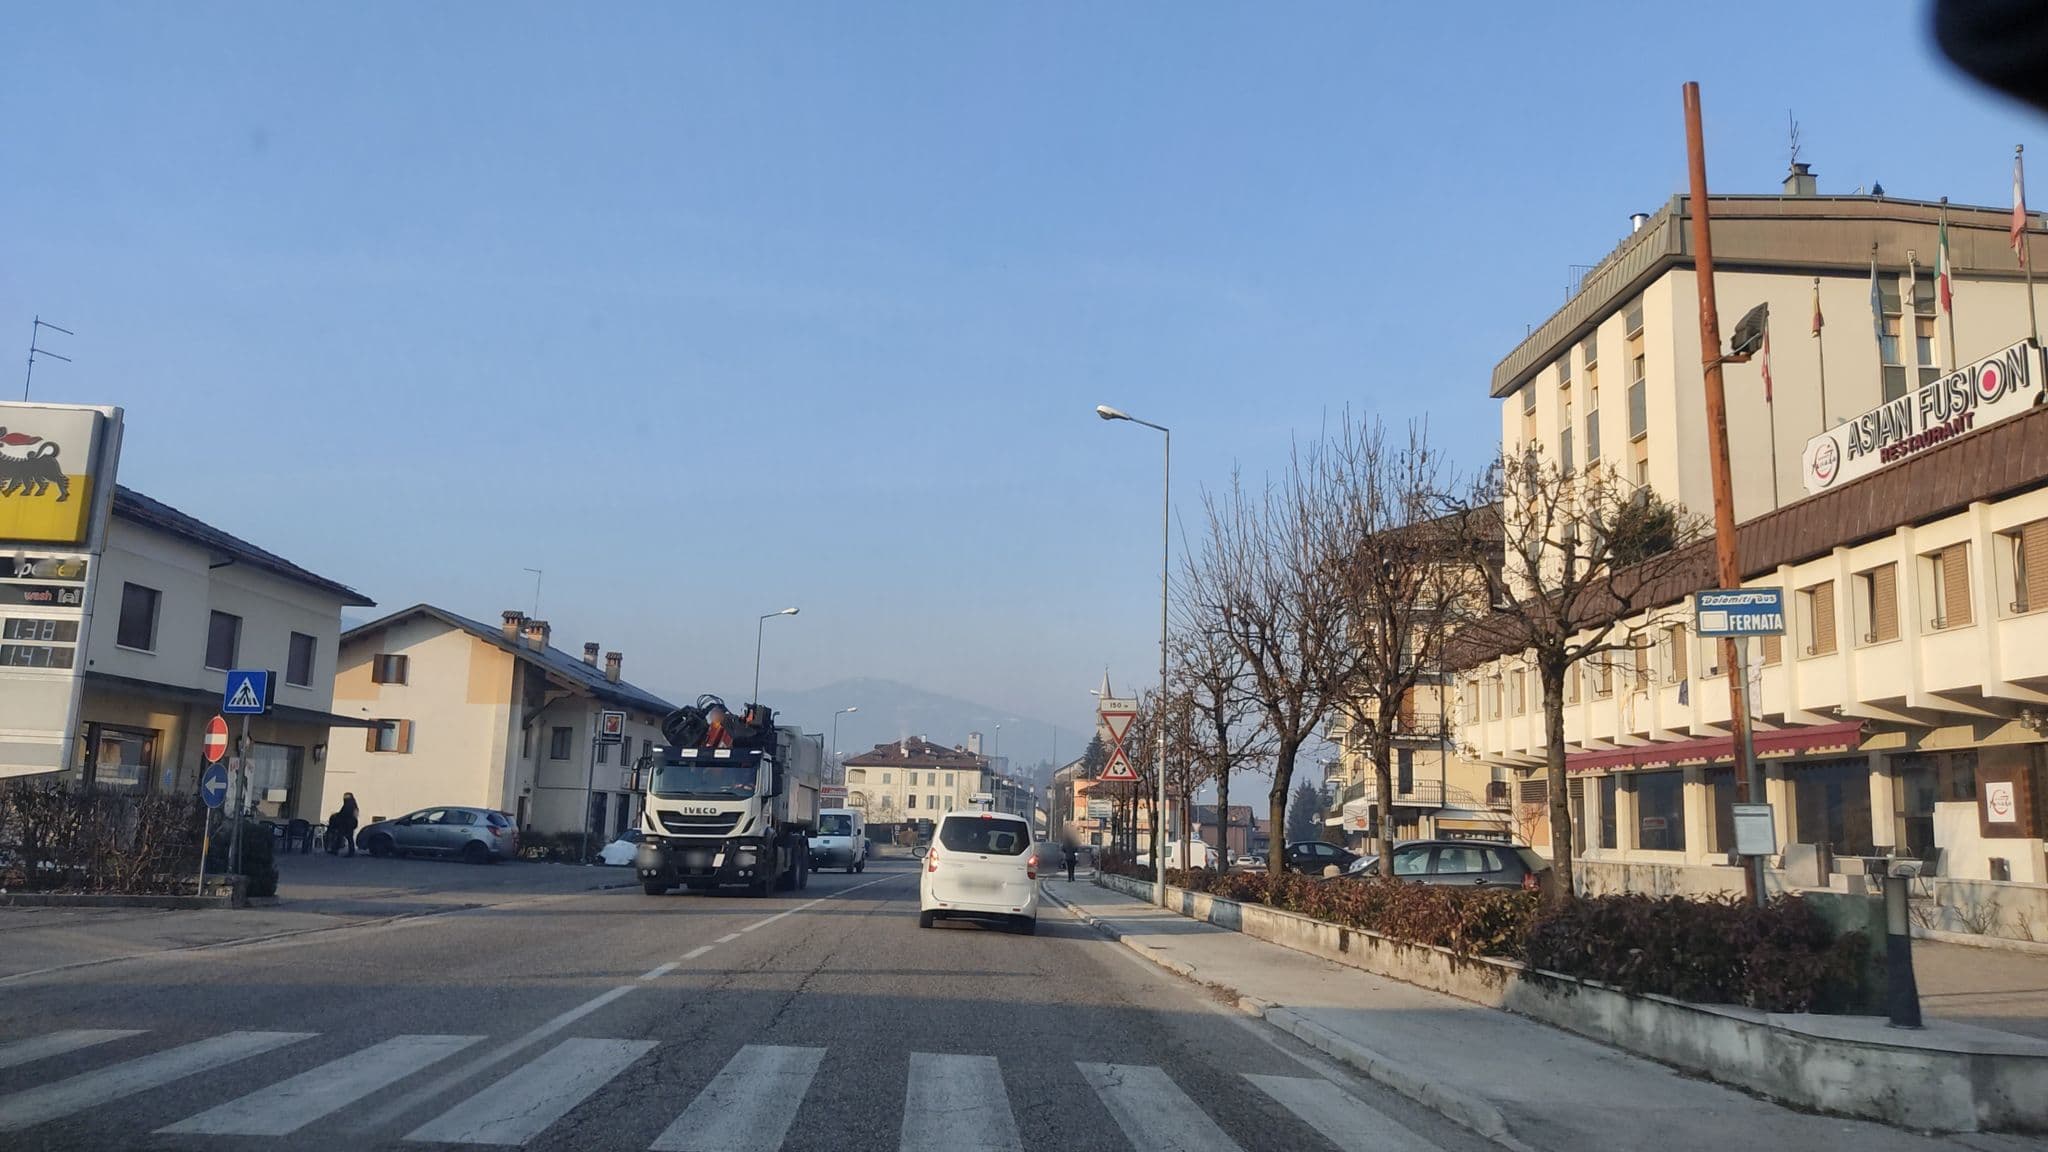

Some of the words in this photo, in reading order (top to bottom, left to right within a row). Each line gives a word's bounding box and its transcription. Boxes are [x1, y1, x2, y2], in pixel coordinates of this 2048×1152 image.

[1847, 397, 1913, 461] ASIAN
[1919, 343, 2031, 429] FUSION
[1880, 412, 1975, 464] RESTAURANT
[24, 589, 52, 601] wash
[1729, 614, 1783, 631] FERMATA
[684, 807, 717, 815] IVECO
